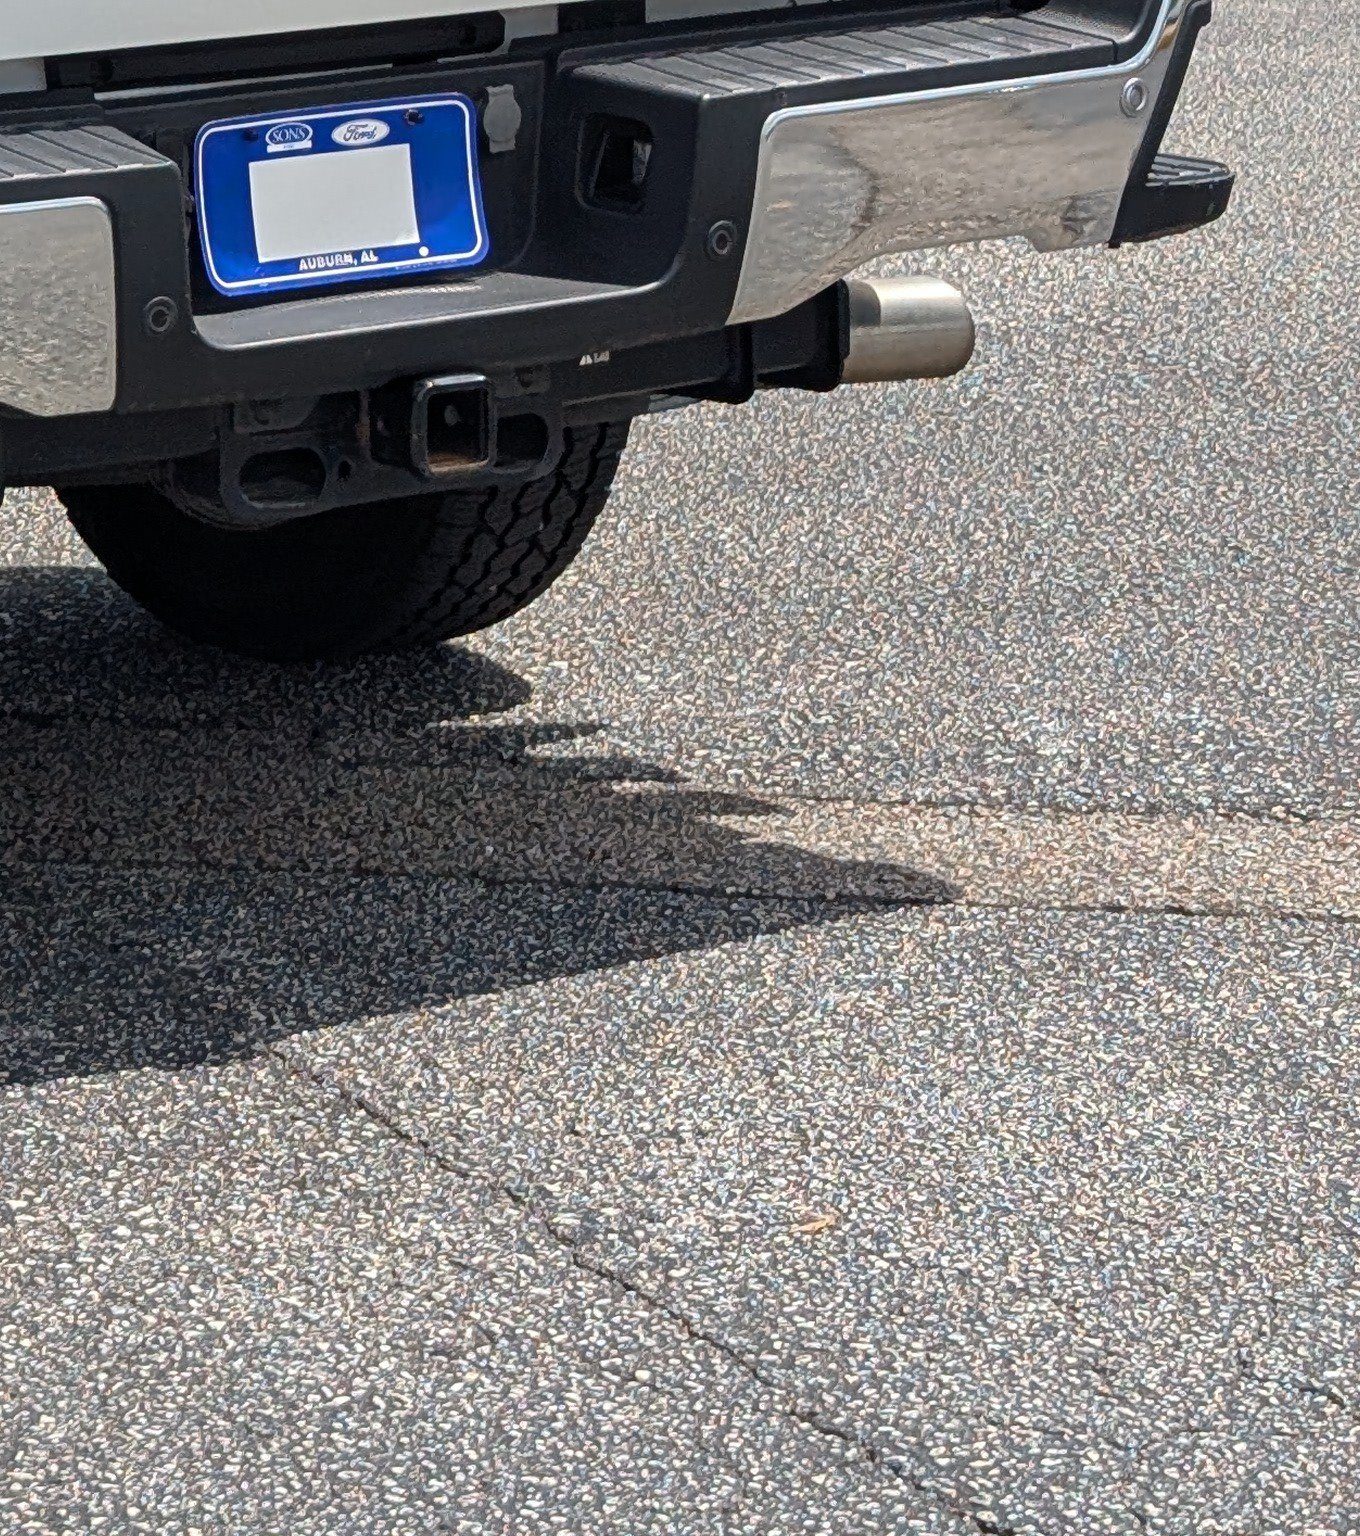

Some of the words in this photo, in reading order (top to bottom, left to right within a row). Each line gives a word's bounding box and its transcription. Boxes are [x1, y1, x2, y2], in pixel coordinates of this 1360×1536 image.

[272, 127, 306, 144] SONS
[342, 124, 378, 143] Ford
[360, 249, 379, 264] AL
